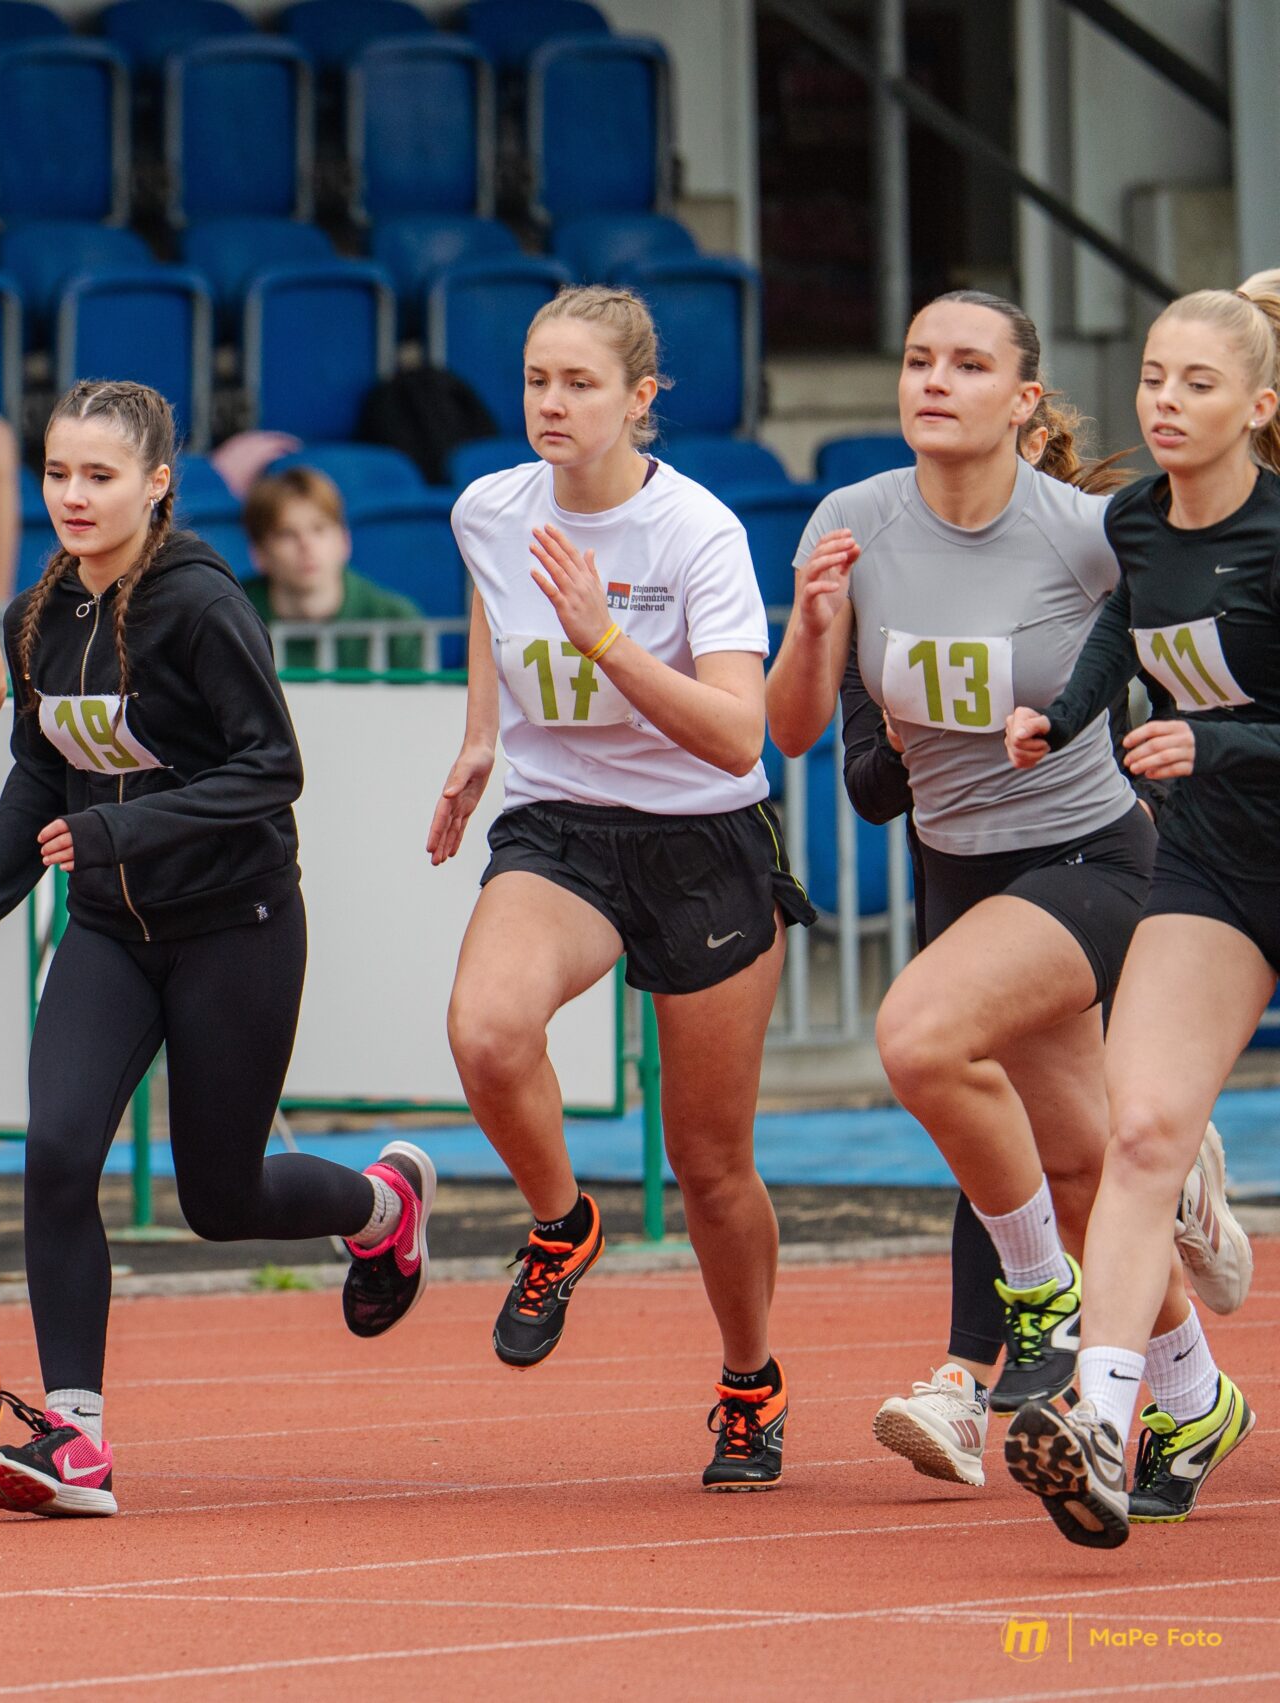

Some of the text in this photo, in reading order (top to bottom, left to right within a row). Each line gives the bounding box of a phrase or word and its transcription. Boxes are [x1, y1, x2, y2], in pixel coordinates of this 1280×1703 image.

[607, 594, 629, 608] sgv
[629, 603, 666, 612] velehrad
[523, 639, 599, 721] 17
[908, 640, 992, 727] 13
[1150, 627, 1231, 706] 11
[54, 700, 140, 770] 19
